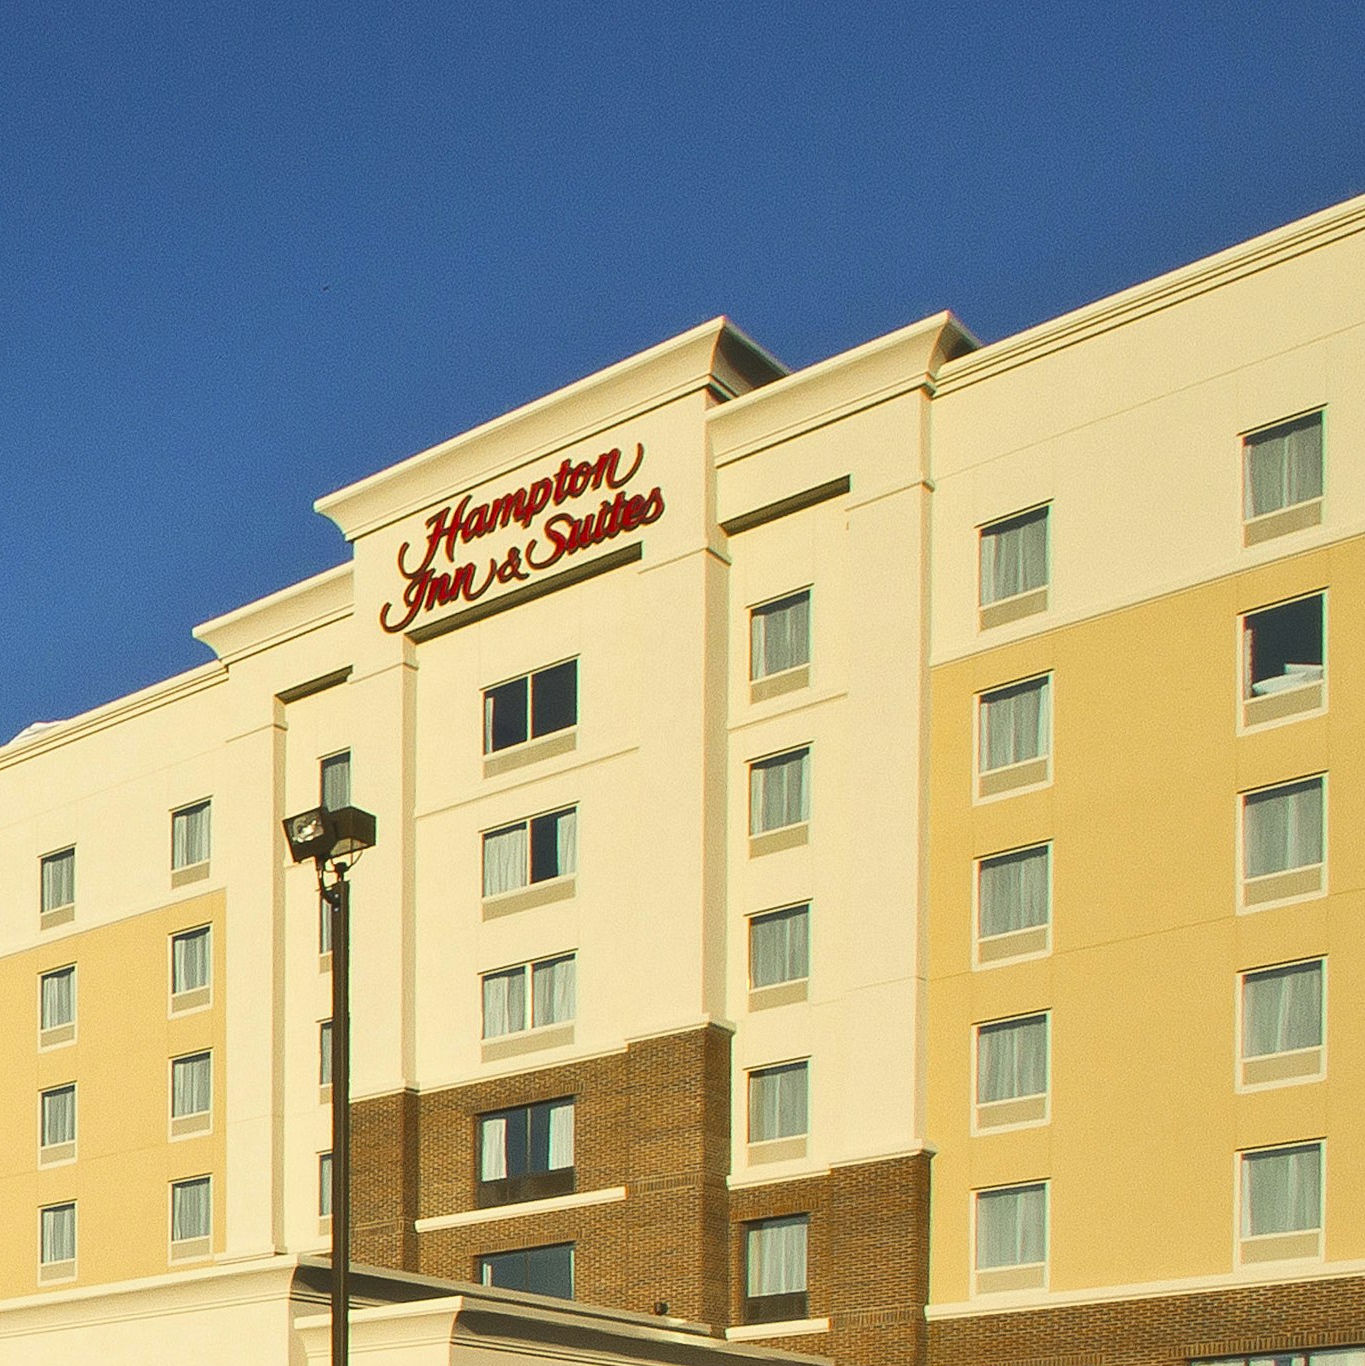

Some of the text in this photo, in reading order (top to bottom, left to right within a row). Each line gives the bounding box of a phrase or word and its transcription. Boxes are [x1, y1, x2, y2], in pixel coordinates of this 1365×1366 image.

[379, 486, 665, 634] Inn & Suites
[397, 442, 645, 579] Hampton
